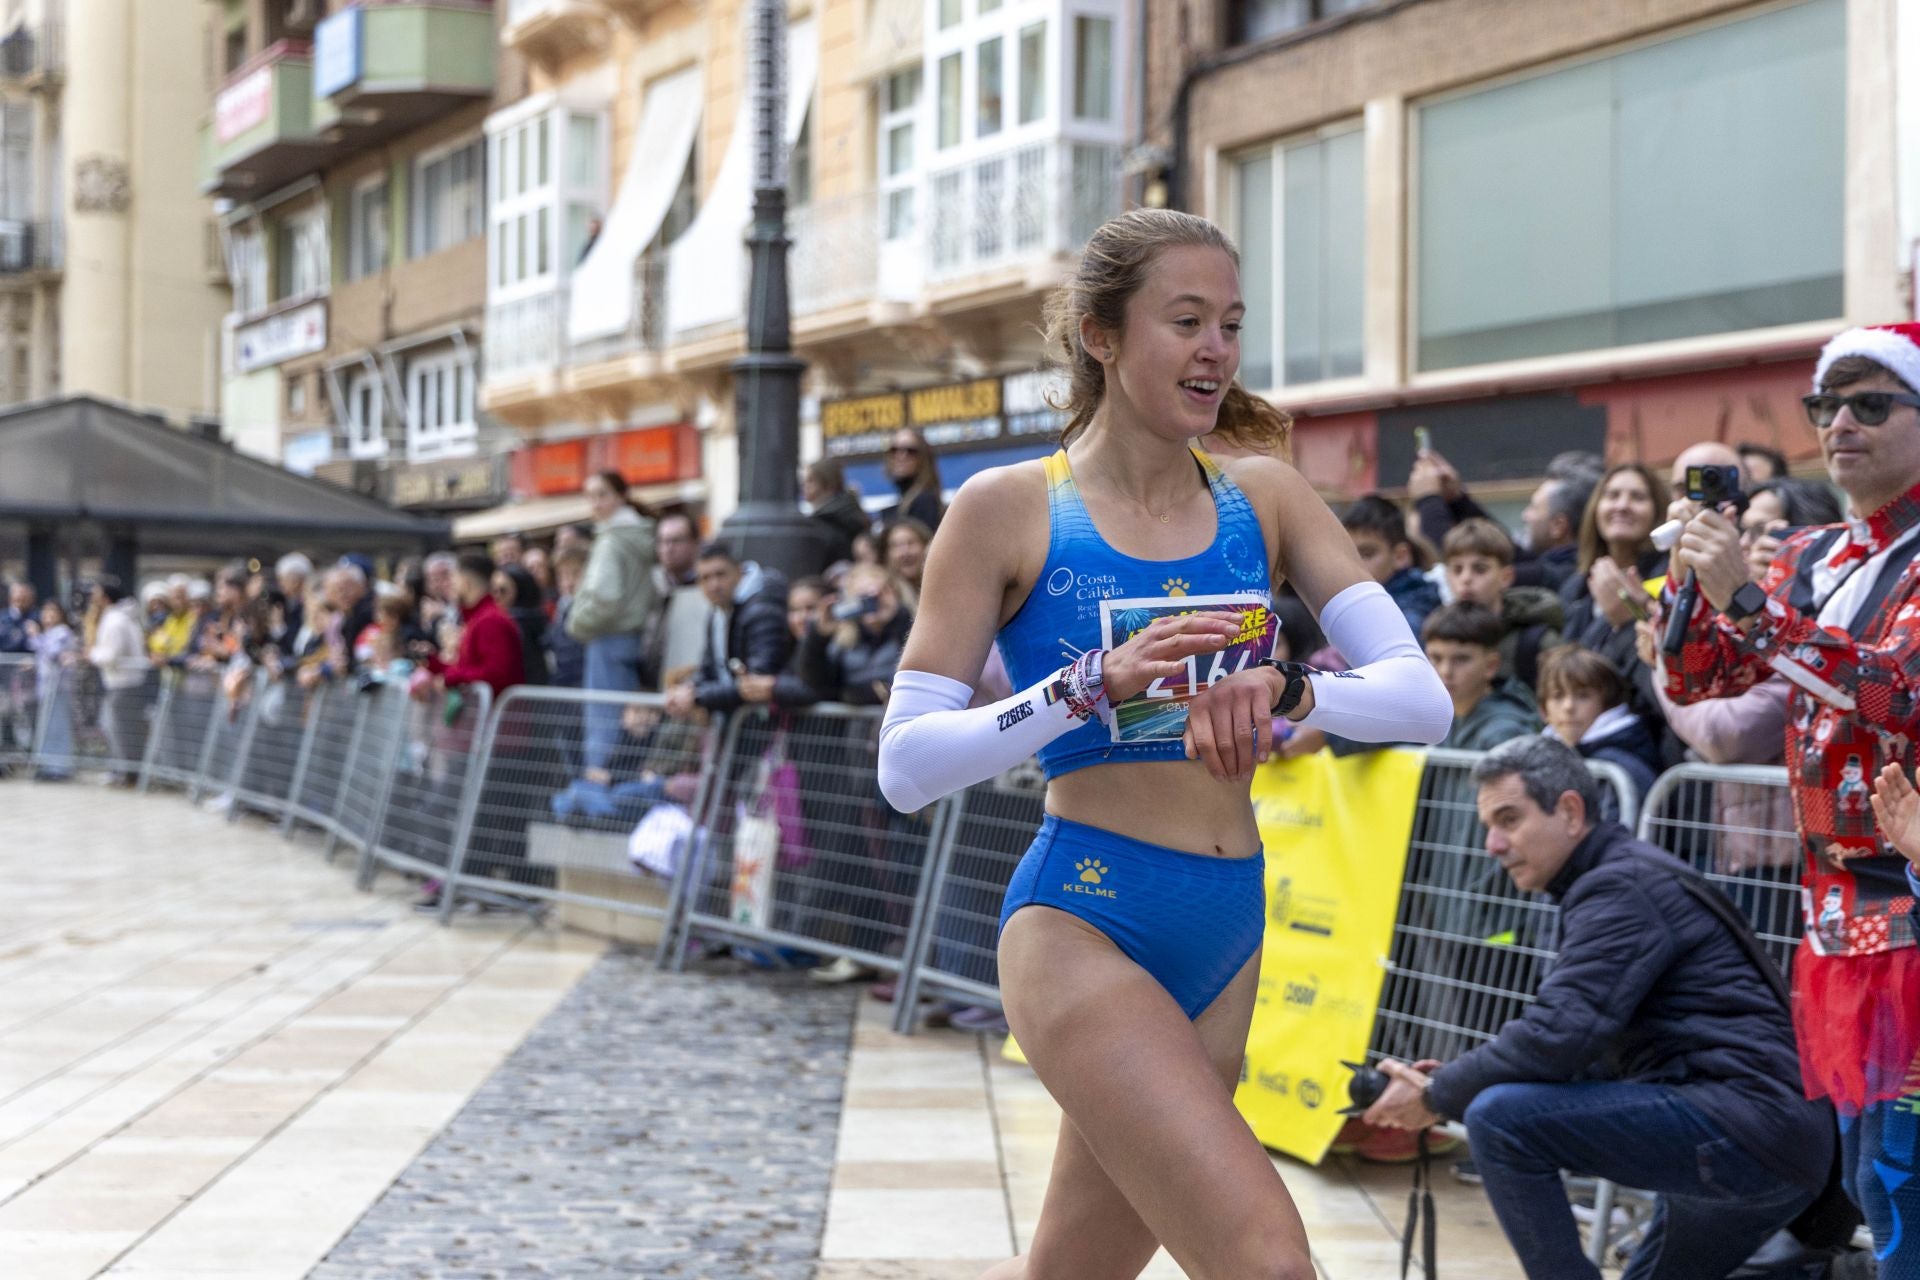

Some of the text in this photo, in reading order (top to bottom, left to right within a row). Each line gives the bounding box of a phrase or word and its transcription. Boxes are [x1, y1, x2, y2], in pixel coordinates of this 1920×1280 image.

[1076, 574, 1117, 586] Costa
[1076, 585, 1125, 600] Cálida
[1146, 650, 1251, 699] 216
[997, 700, 1034, 732] 226ERS
[1063, 883, 1118, 899] KELME
